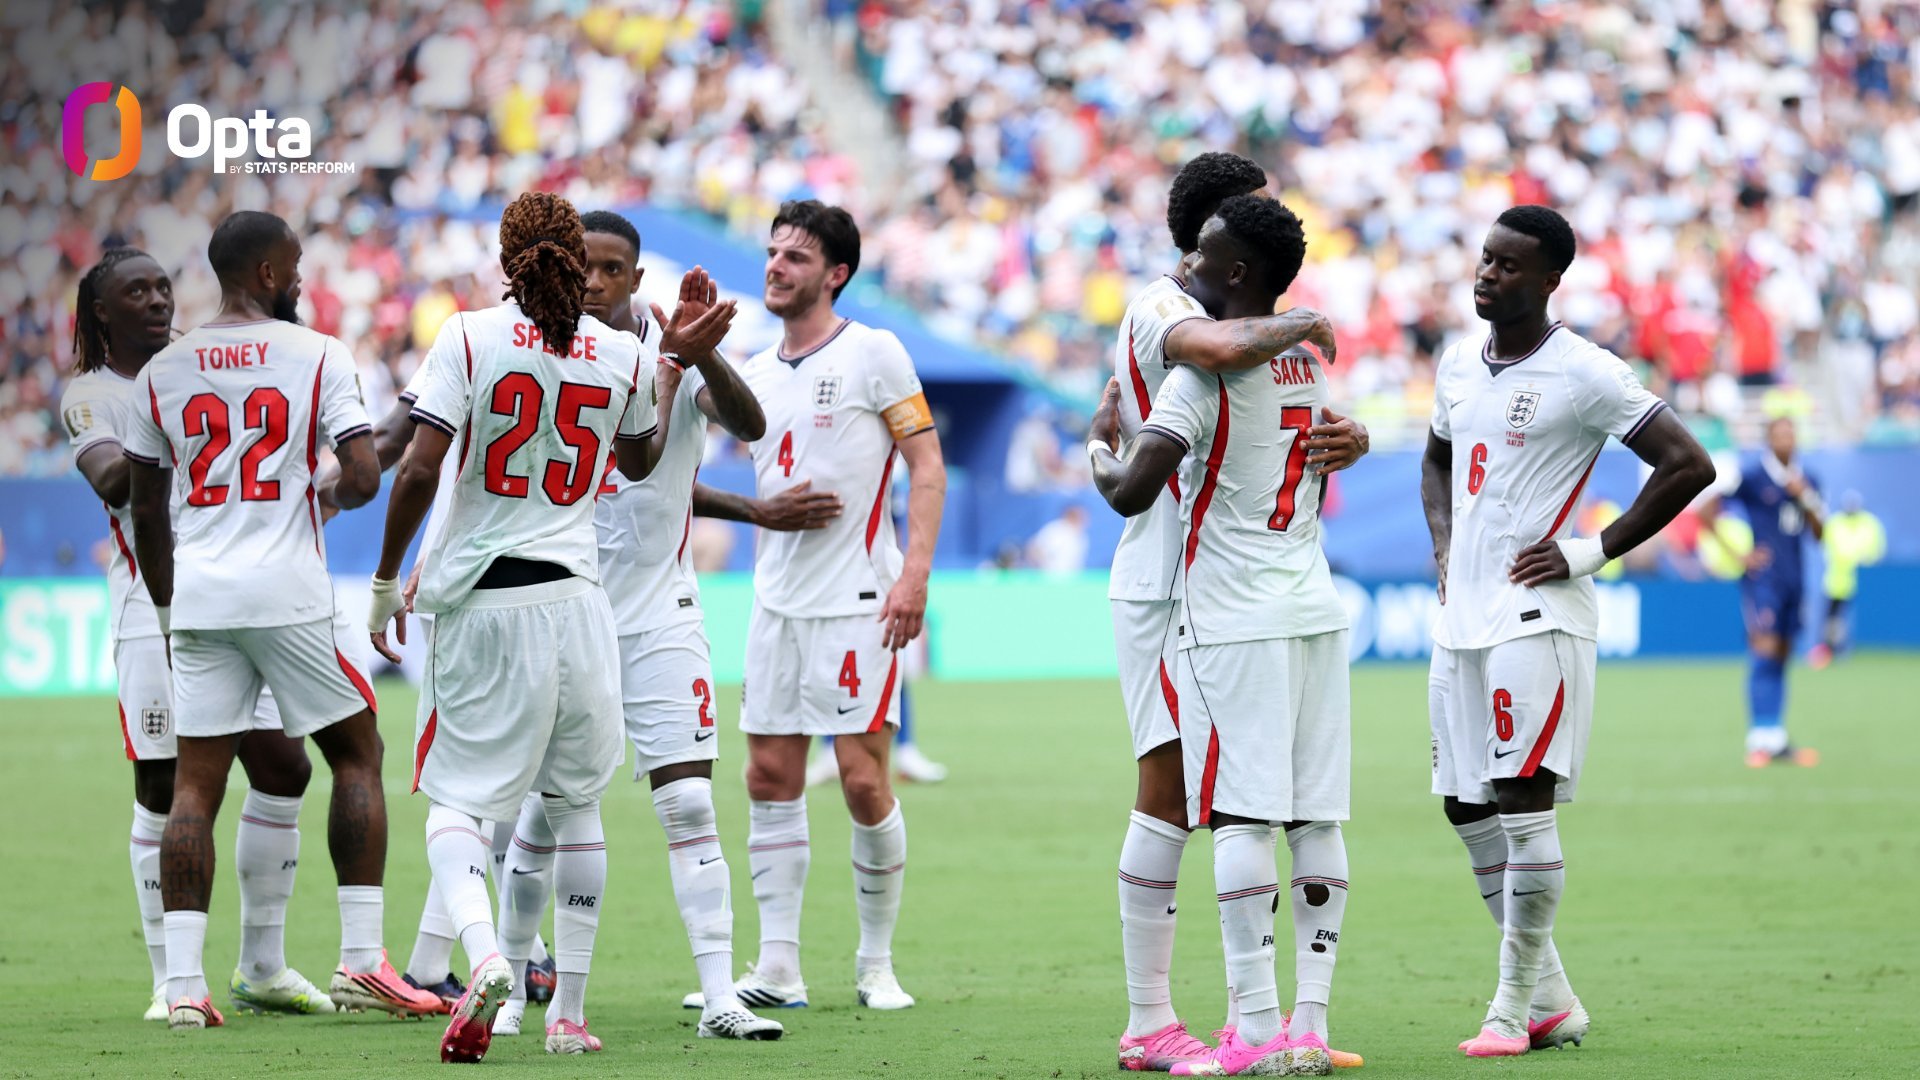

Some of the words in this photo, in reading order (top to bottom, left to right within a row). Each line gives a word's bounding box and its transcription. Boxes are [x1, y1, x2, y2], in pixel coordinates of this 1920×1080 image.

[195, 342, 269, 371] TONEY
[513, 323, 597, 361] SPCE
[1271, 357, 1315, 385] SAKA
[182, 387, 289, 507] 22
[485, 371, 611, 506] 25
[778, 430, 793, 477] 4
[1267, 406, 1312, 531] 7
[1468, 443, 1487, 495] 6
[838, 650, 861, 698] 4
[692, 678, 714, 727] 2
[1493, 688, 1513, 741] 6
[145, 880, 161, 890] EN
[568, 894, 596, 908] ENG
[1262, 935, 1275, 947] EN
[1316, 929, 1339, 943] ENG
